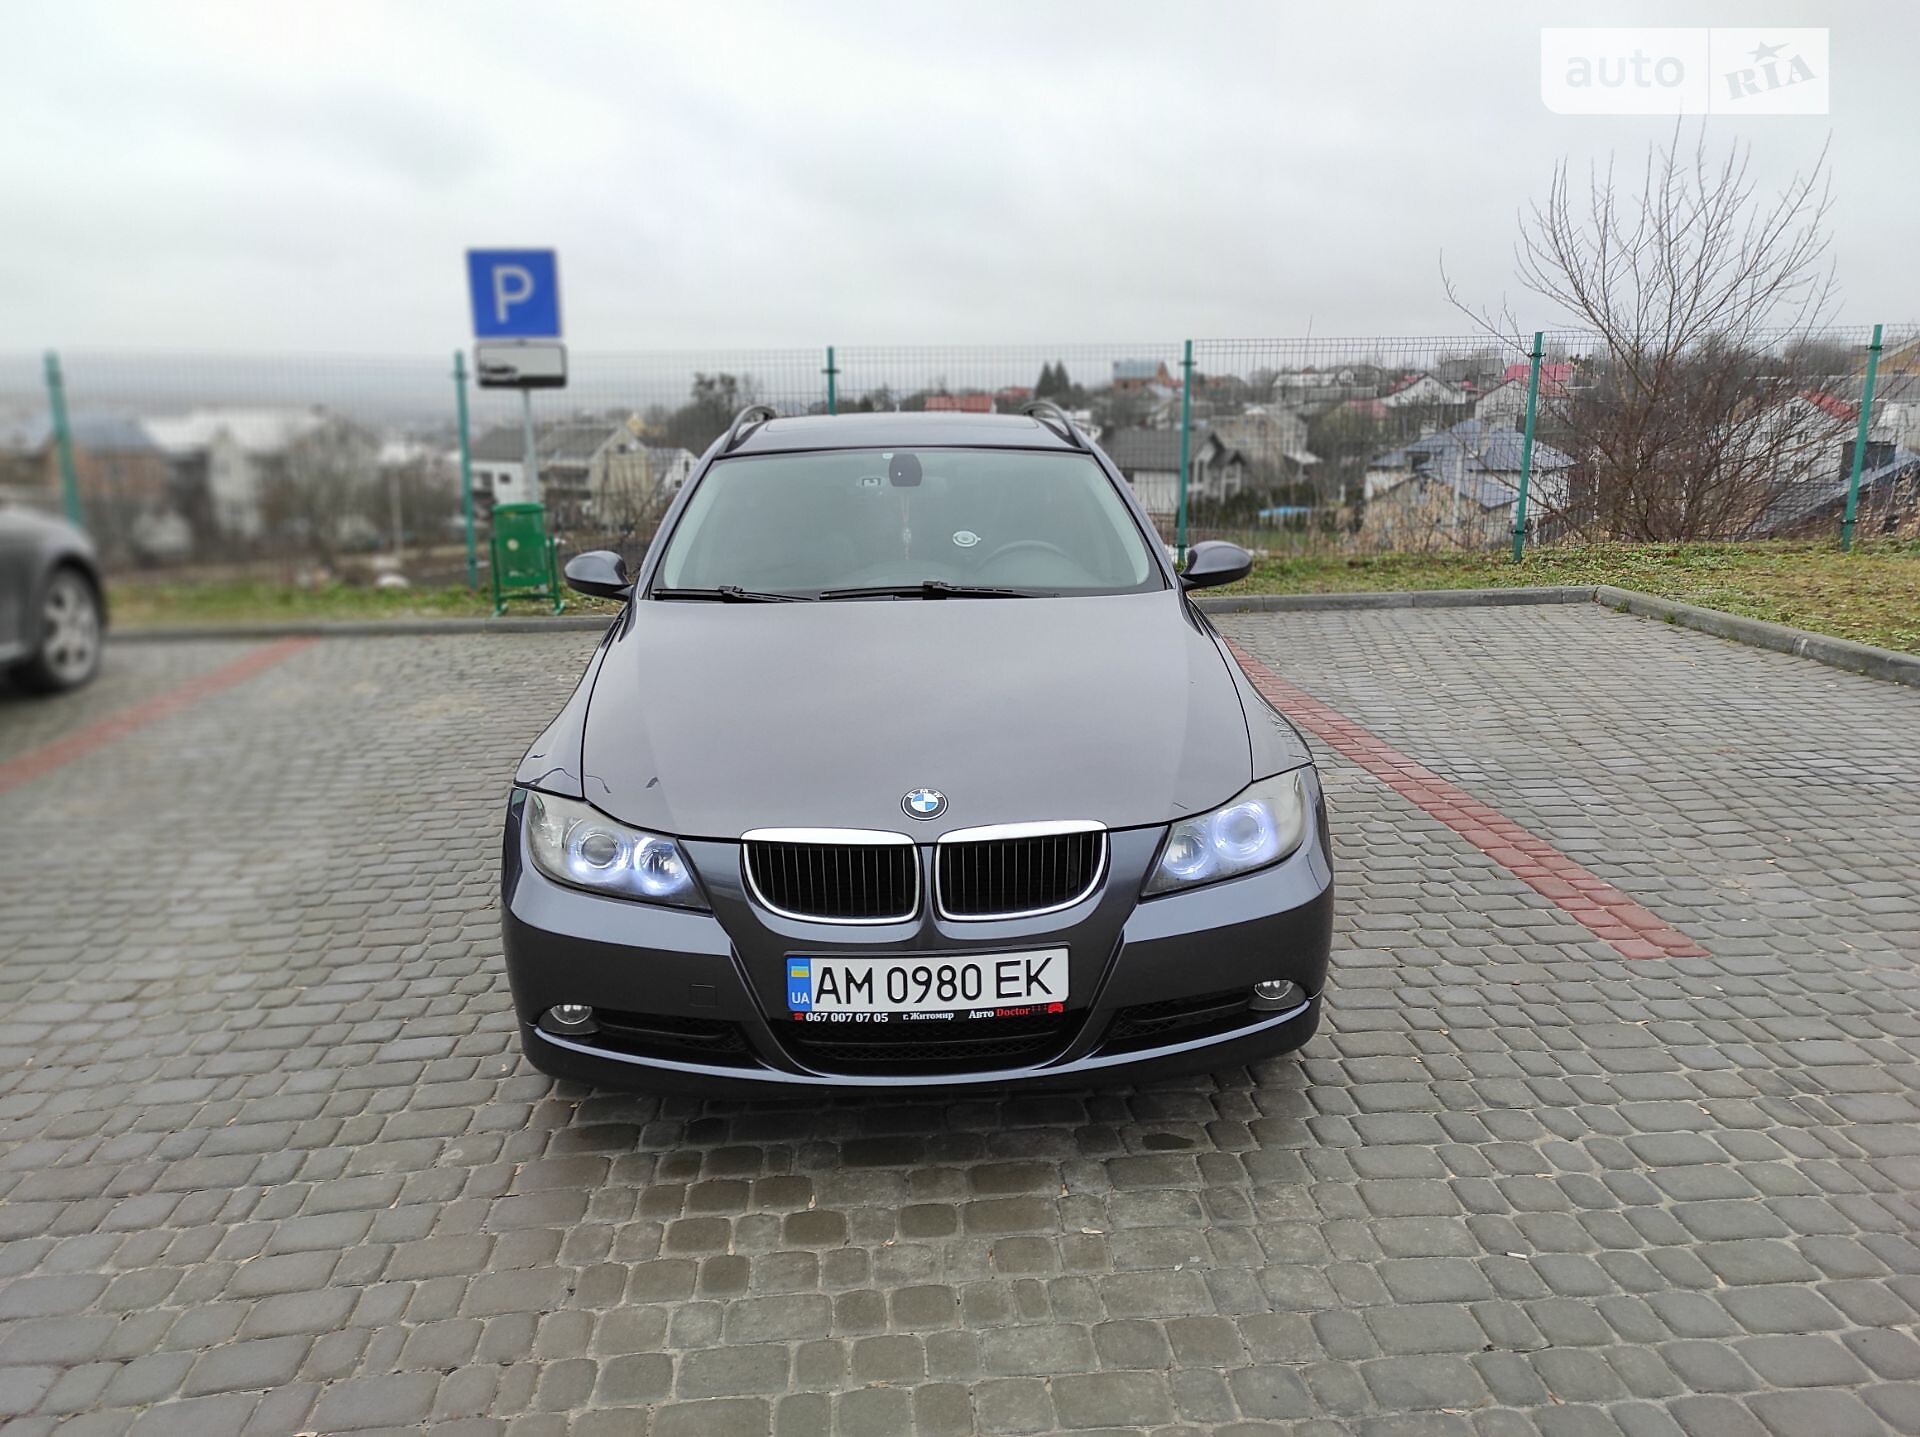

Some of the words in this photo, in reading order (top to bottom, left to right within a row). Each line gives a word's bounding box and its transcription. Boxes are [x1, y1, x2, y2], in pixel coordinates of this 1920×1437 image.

[493, 265, 535, 323] P
[814, 966, 874, 1004] AM
[886, 963, 983, 1004] 0980
[995, 957, 1053, 999] EK
[791, 991, 811, 1005] UA
[805, 1012, 829, 1022] 067
[830, 1012, 854, 1023] 007
[855, 1012, 872, 1023] 07
[873, 1012, 889, 1023] 05
[968, 1010, 995, 1019] Авто
[996, 1006, 1031, 1017] Doctor
